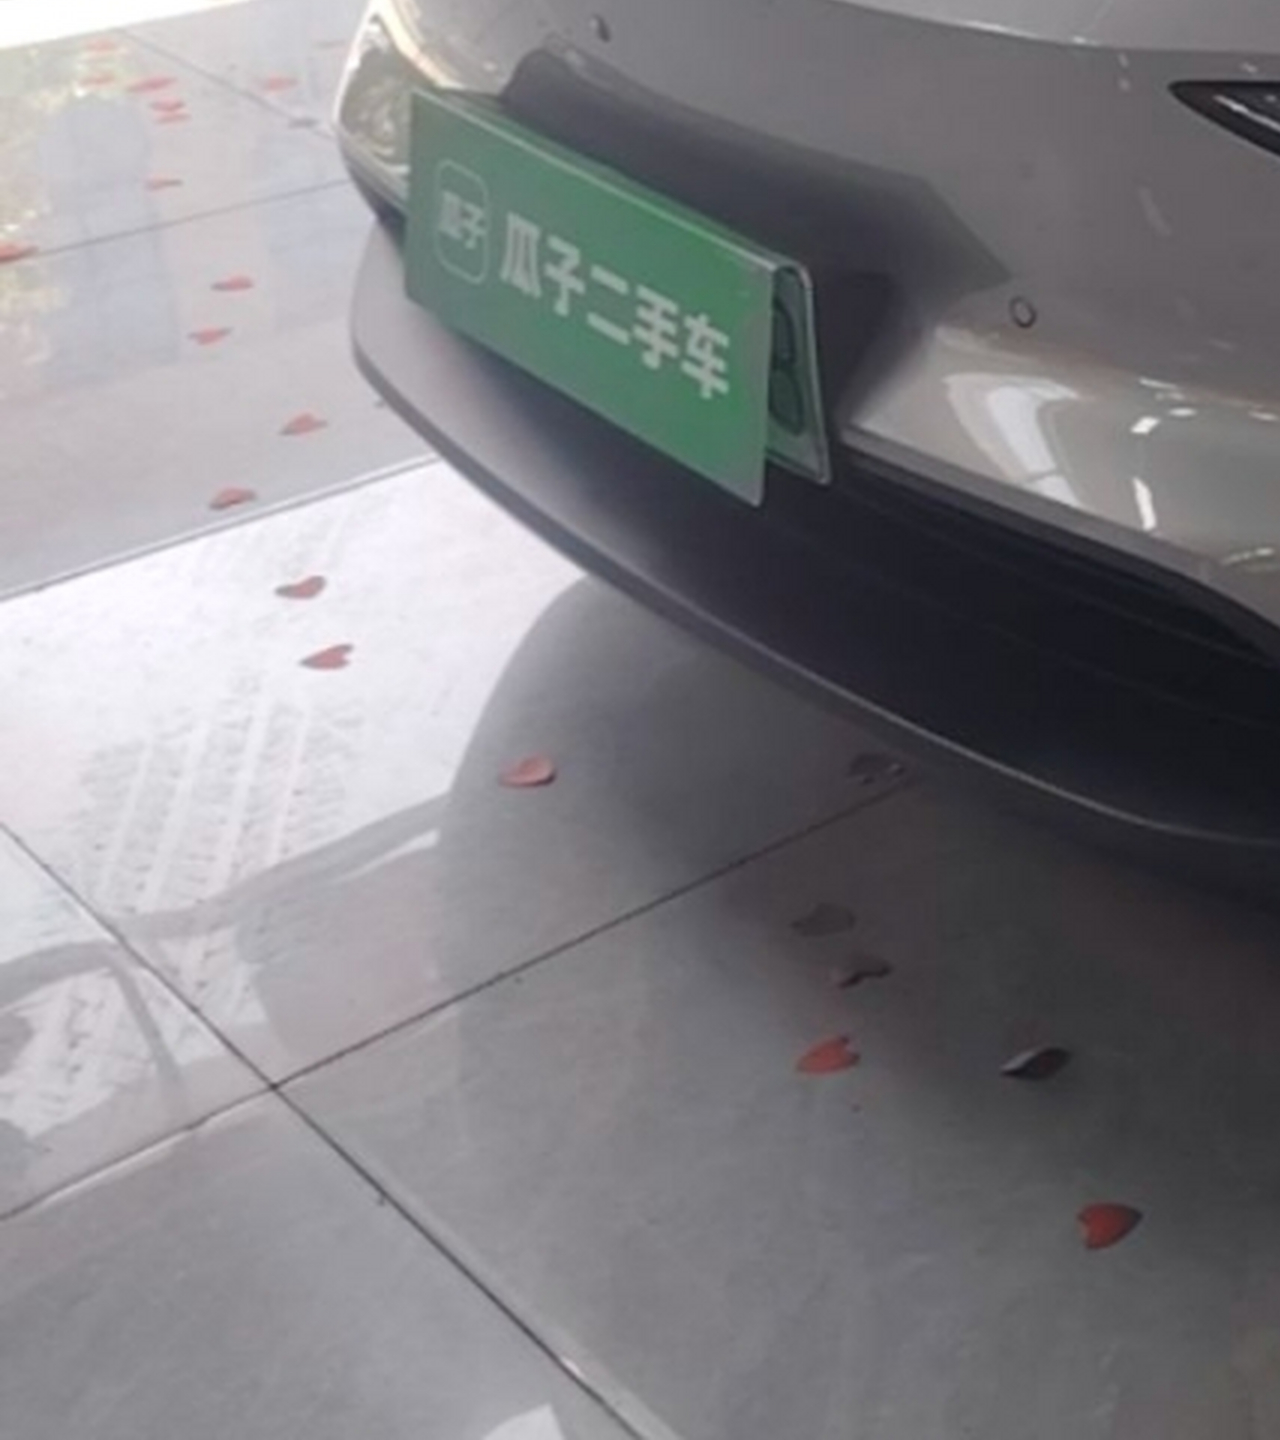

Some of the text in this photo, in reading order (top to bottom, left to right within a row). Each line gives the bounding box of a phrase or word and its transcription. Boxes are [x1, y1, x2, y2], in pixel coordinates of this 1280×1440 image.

[500, 210, 730, 401] 瓜子二手车
